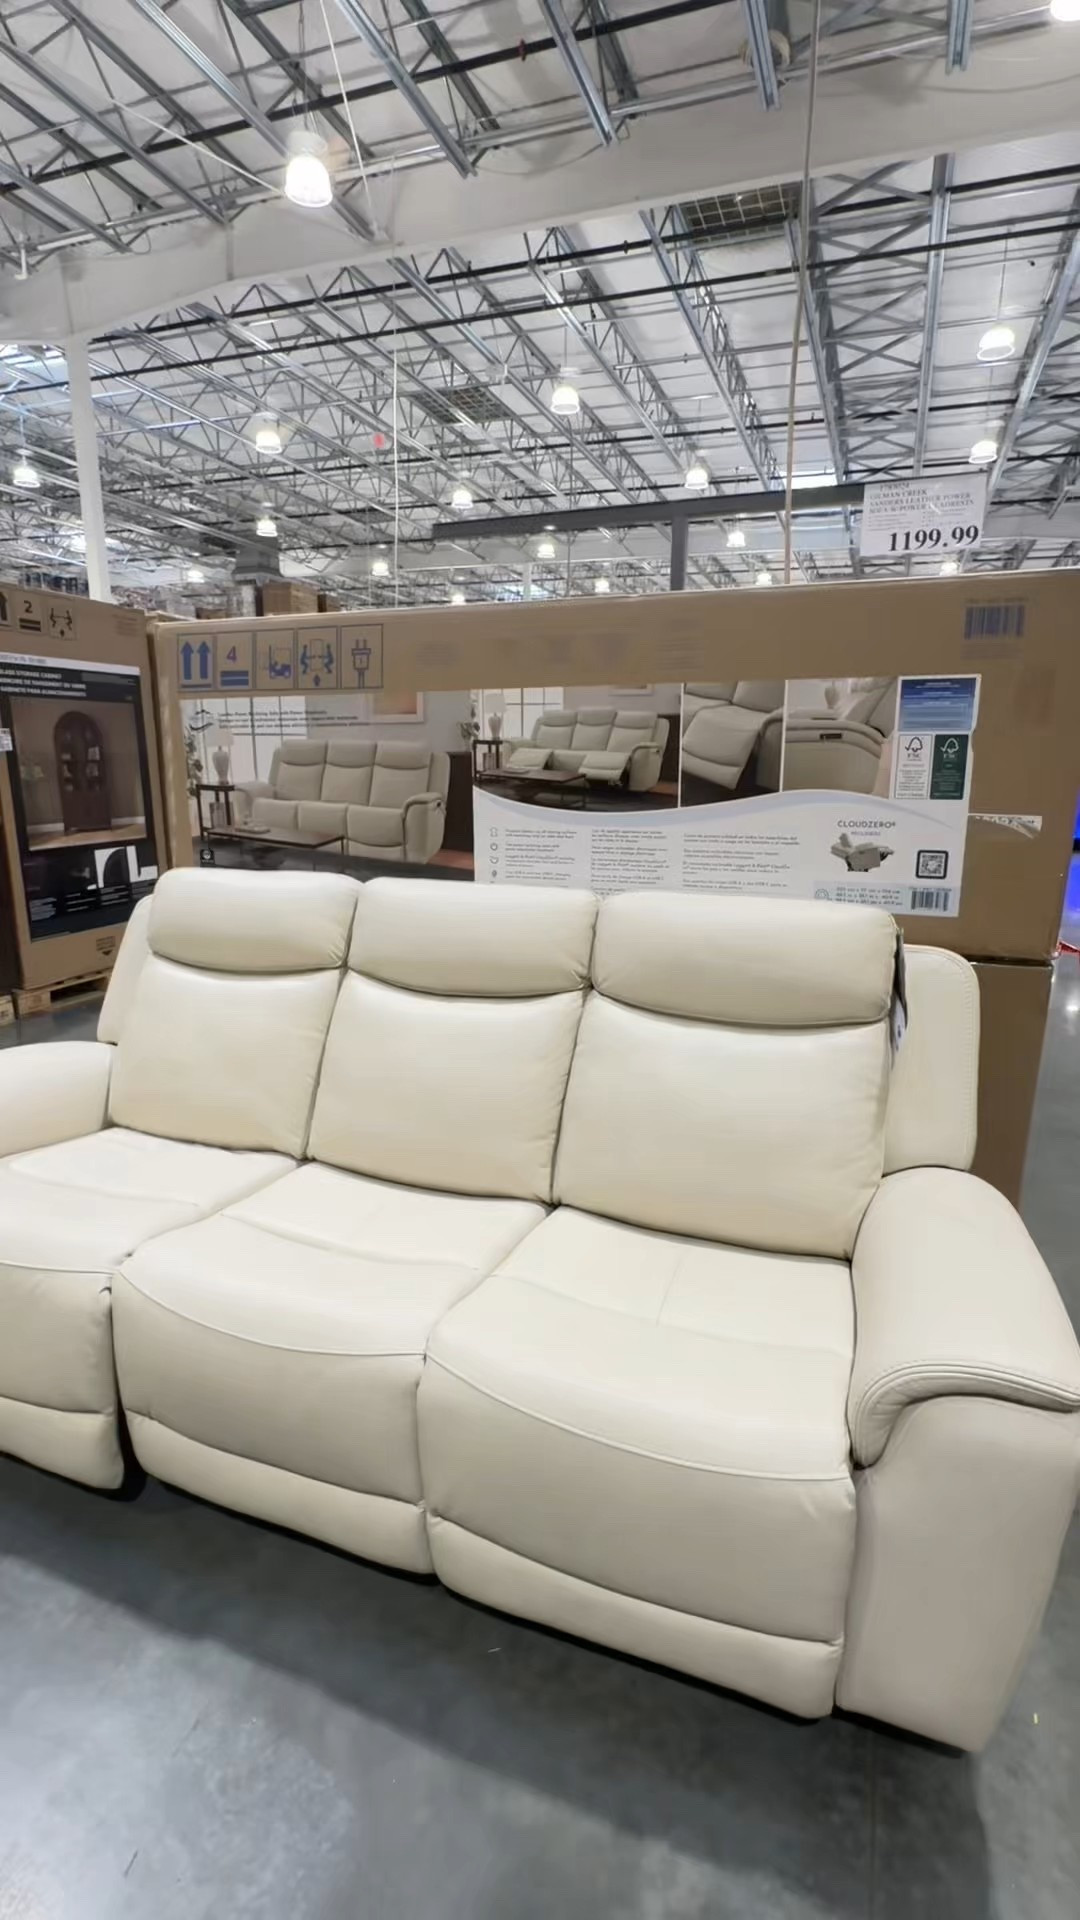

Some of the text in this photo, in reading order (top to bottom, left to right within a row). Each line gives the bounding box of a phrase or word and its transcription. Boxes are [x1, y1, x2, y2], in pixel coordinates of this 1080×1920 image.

[943, 492, 971, 500] POWER
[889, 525, 979, 551] 1199.99
[23, 600, 33, 613] 2
[226, 645, 238, 664] 4
